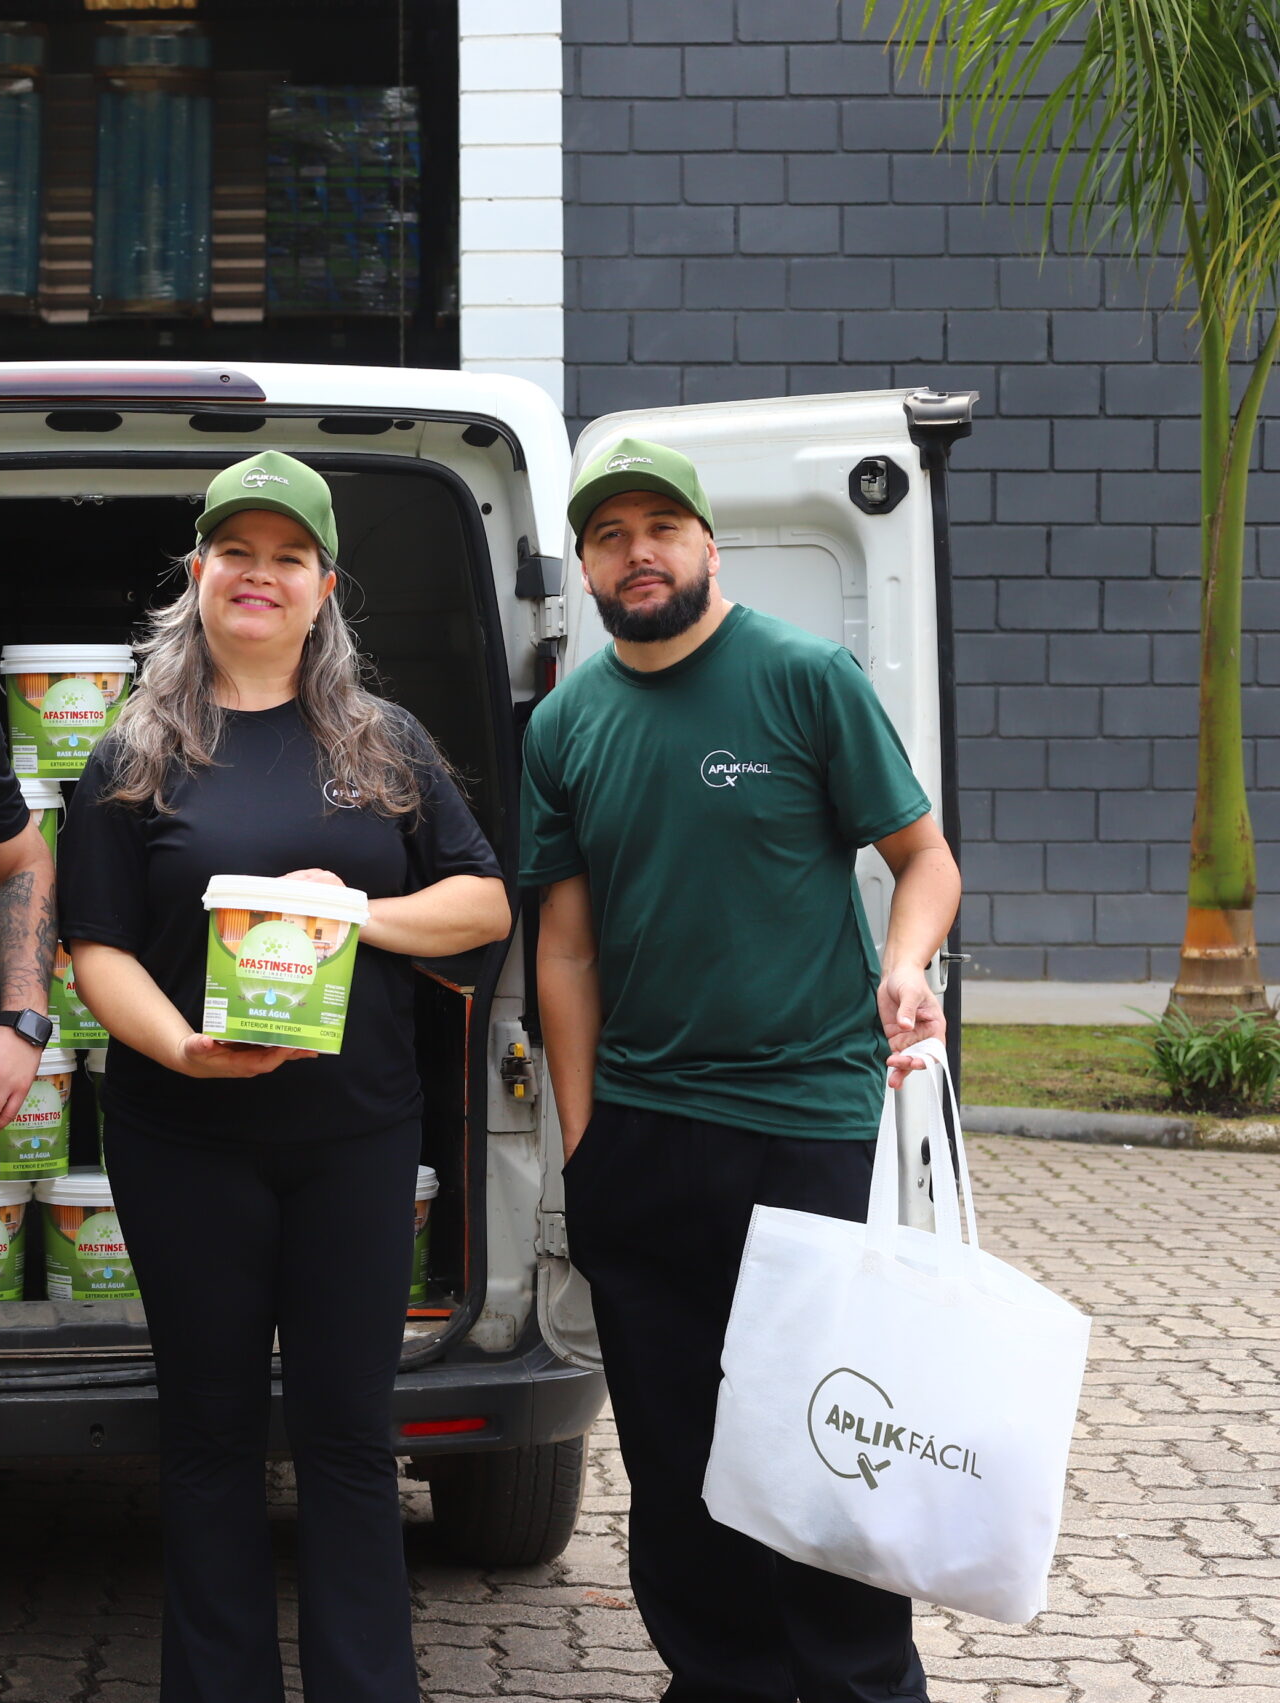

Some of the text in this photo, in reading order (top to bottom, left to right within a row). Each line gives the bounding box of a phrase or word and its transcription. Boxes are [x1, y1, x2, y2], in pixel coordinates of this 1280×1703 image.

[43, 711, 104, 719] AFASTINSETOS
[708, 761, 772, 774] APLIKFÁCIL
[239, 958, 313, 975] AFASTINSETOS
[248, 1008, 291, 1019] BASE ÁGUA
[240, 1020, 268, 1029] EXTERIOR
[275, 1024, 302, 1032] INTERIOR
[824, 1404, 982, 1480] APLIKFÁCIL
